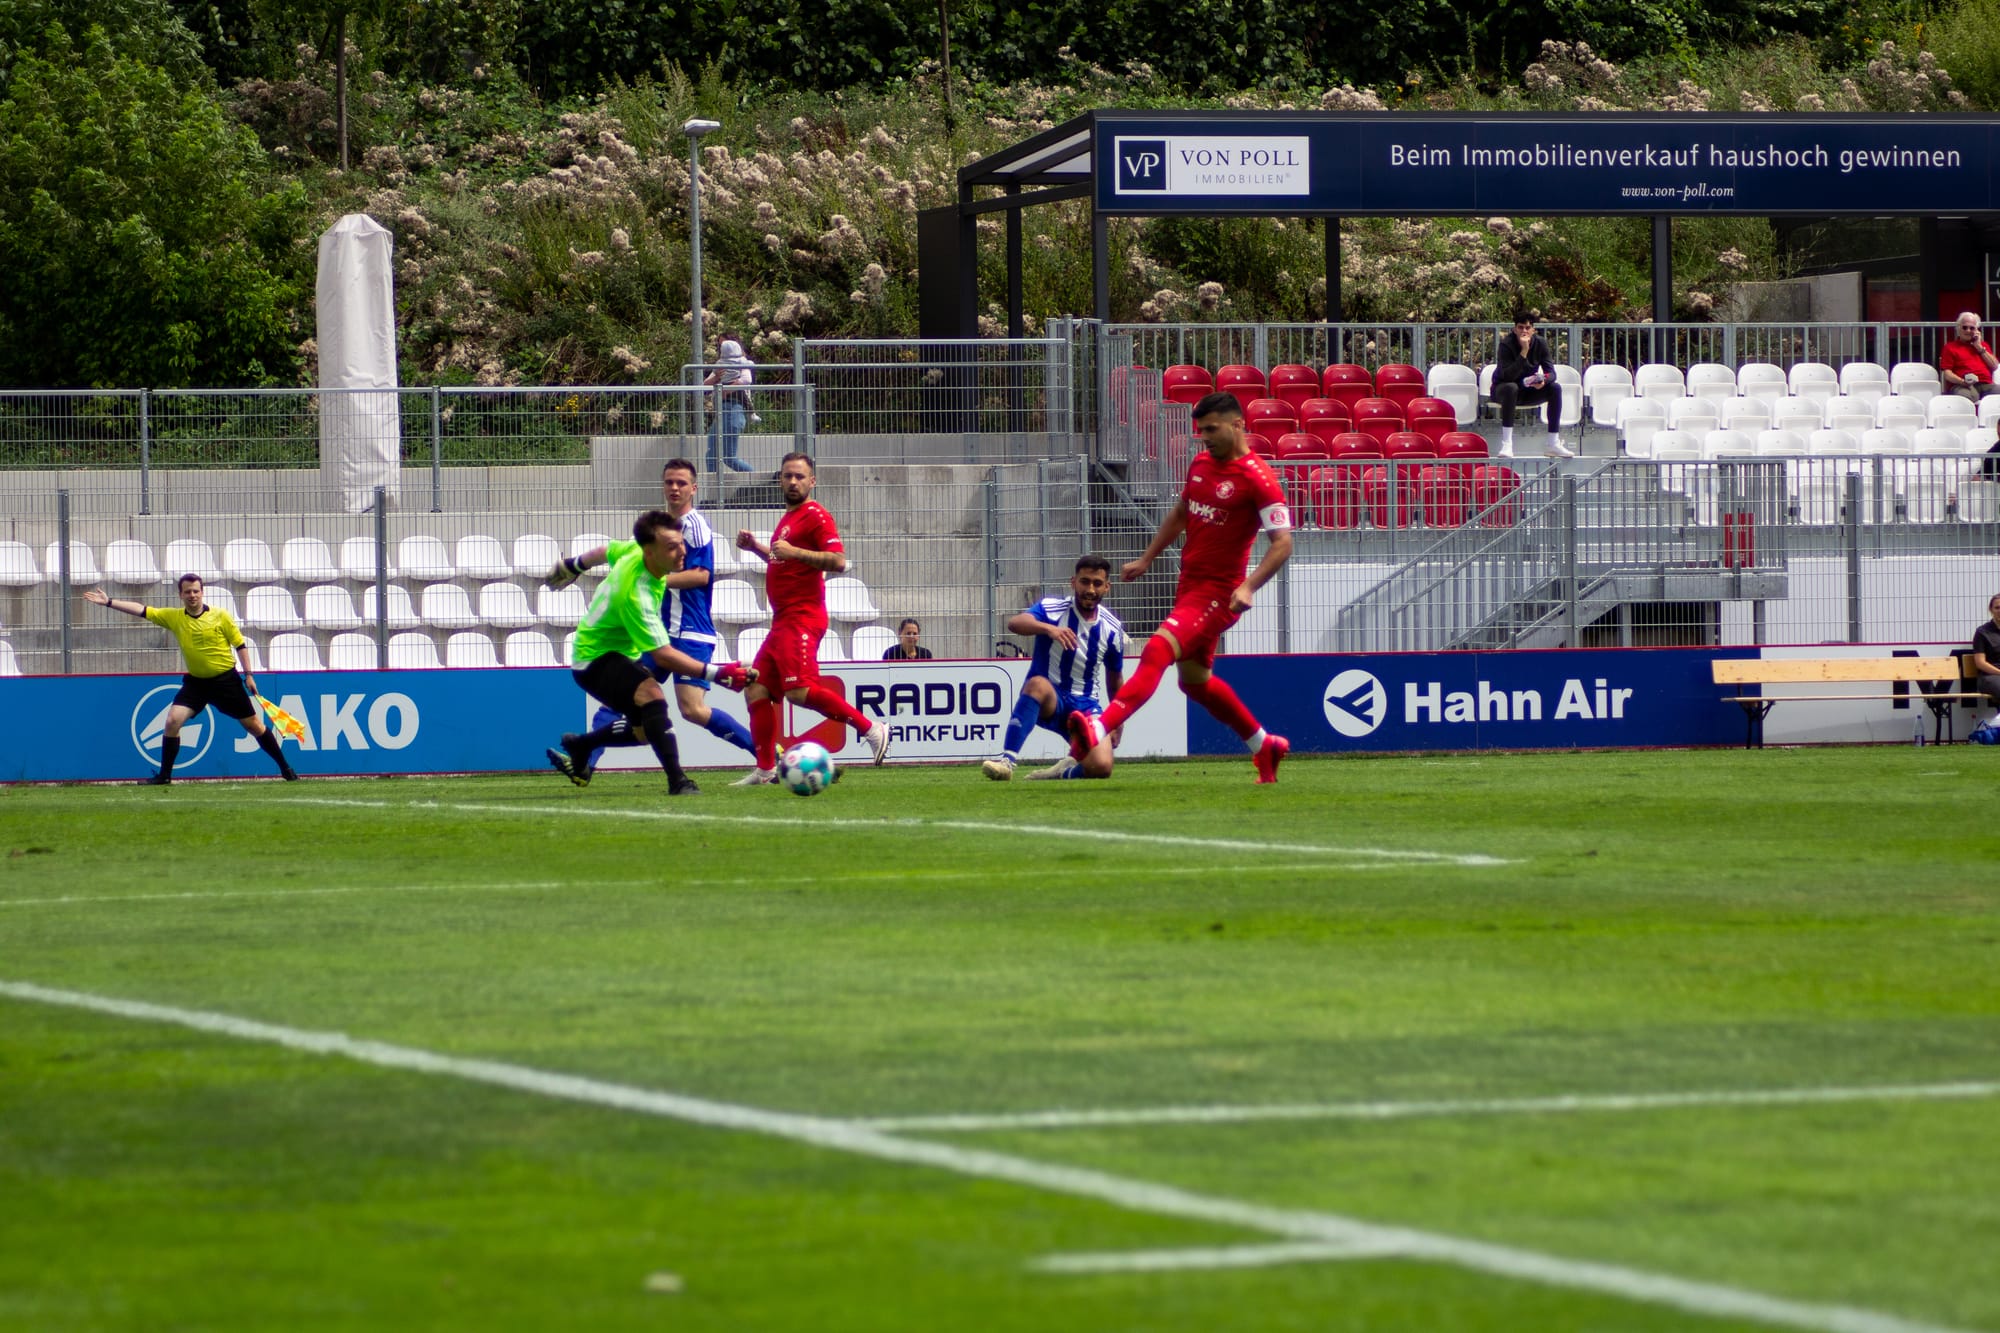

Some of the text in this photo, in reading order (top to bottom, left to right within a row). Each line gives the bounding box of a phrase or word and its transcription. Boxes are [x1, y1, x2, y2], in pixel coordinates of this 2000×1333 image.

[1125, 152, 1160, 177] VP
[1180, 149, 1300, 166] VON POLL
[1391, 144, 1961, 173] Beim Immobilienverkauf haushoch gewinnen
[1621, 183, 1735, 201] www.von-poll.com
[855, 682, 1001, 717] RADIO
[1404, 678, 1633, 723] Hahn Air
[234, 692, 420, 753] JAKO
[857, 724, 1000, 743] ANKFURT
